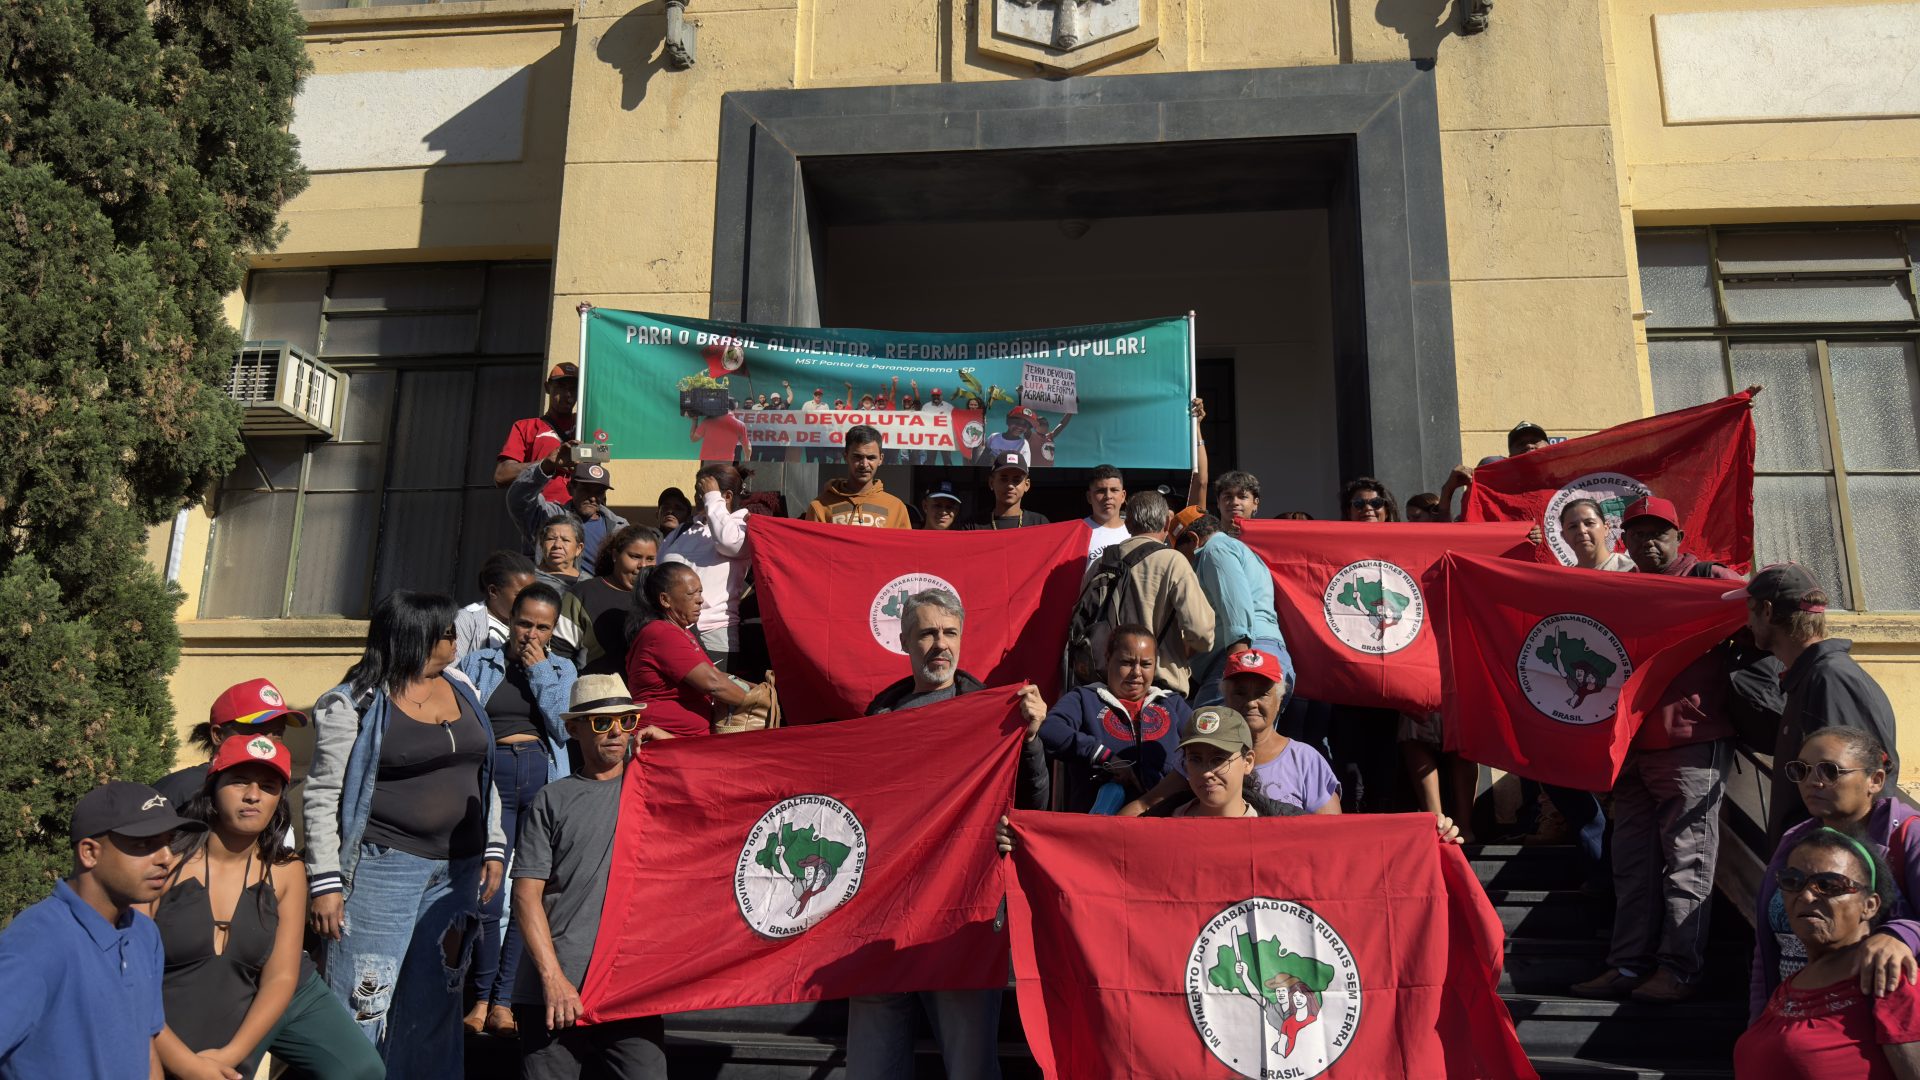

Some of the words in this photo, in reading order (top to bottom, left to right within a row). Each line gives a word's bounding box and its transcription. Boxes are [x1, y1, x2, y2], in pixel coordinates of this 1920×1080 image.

[626, 325, 673, 345] PARA
[678, 330, 690, 345] O
[696, 331, 760, 349] BRASIL
[767, 337, 877, 360] ALIMENTAR,
[885, 343, 968, 360] REFORMA
[976, 337, 1050, 359] AGRÁRIA
[1056, 336, 1147, 358] POPULAR!
[795, 357, 818, 366] MST
[819, 359, 853, 368] Pontal
[871, 364, 953, 373] Paranapanema
[961, 366, 976, 374] SP
[1026, 364, 1046, 375] TERRA
[804, 413, 931, 427] DEVOLUTA
[796, 430, 822, 443] DE
[828, 431, 889, 444] QM
[896, 432, 954, 447] LUTA
[1329, 577, 1341, 591] DOS
[1339, 560, 1403, 578] TRABALHADORES
[1402, 574, 1420, 601] RURAIS
[1519, 643, 1533, 693] MOVIMENTO
[1530, 627, 1542, 643] DOS
[1541, 615, 1609, 637] TRABALHADORES
[1608, 635, 1629, 667] RURAIS
[1551, 709, 1584, 722] BRASIL
[737, 849, 754, 914] MOVIMENTO
[748, 824, 764, 847] DOS
[762, 796, 844, 824] TRABALHADORES
[842, 811, 865, 849] RURAIS
[854, 851, 866, 875] SEM
[768, 921, 808, 935] BRASIL
[1207, 900, 1315, 936] TRABALHADORES
[1197, 937, 1211, 965] DOS
[1315, 921, 1352, 969] RURAIS
[1345, 971, 1358, 1000] SEM
[1189, 966, 1222, 1049] MOVIMENTO
[1332, 1004, 1358, 1048] TERRA
[1259, 1065, 1305, 1079] BRASIL
